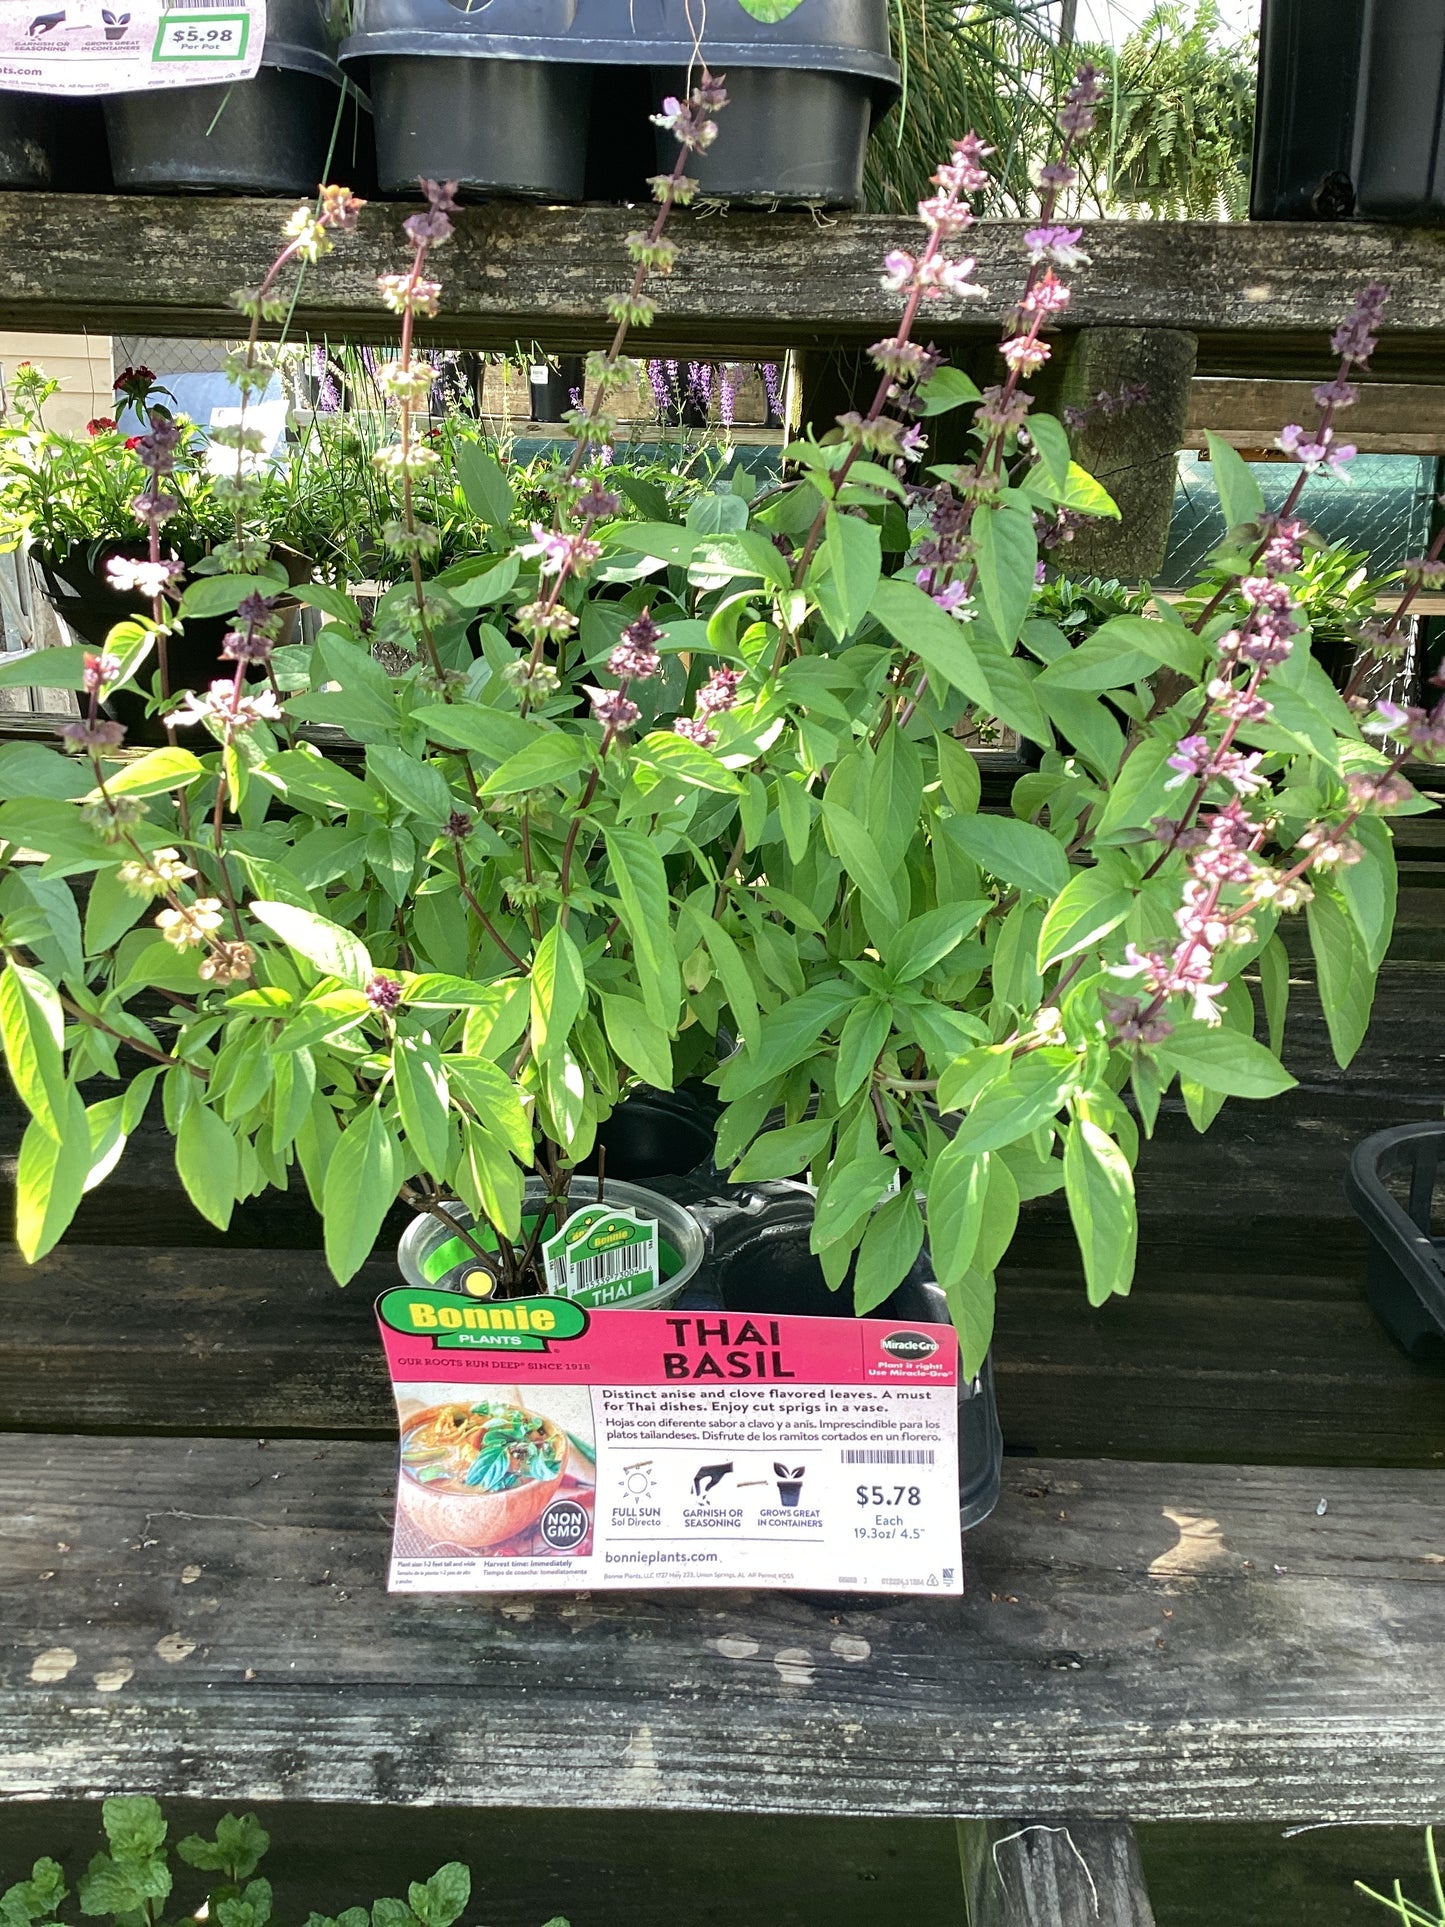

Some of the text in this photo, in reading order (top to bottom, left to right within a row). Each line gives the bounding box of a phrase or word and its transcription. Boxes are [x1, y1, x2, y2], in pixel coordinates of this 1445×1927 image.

[172, 29, 233, 43] $5.98
[592, 1280, 632, 1306] THAI
[408, 1303, 556, 1331] Bonnie
[665, 1318, 780, 1347] THAI
[459, 1334, 522, 1346] PLANTS
[397, 1357, 423, 1366] OUR
[424, 1358, 463, 1367] ROOTS
[465, 1359, 489, 1368] RUN
[527, 1362, 563, 1370] SINCE
[565, 1363, 591, 1371] 1918
[663, 1351, 796, 1379] BASIL
[915, 1362, 943, 1371] right!
[602, 1388, 932, 1400] Distinct anise and clove flavored leaves. A must
[603, 1401, 888, 1414] for Thai dishes. Enjoy cut sprigs in a vase.
[605, 1417, 635, 1429] Hojas
[658, 1418, 707, 1428] diferente
[708, 1418, 736, 1428] sabor
[747, 1419, 775, 1428] clavo
[777, 1421, 783, 1431] y
[785, 1421, 791, 1429] a
[819, 1419, 898, 1431] Imprescindible
[899, 1421, 923, 1431] para
[925, 1420, 941, 1429] los
[606, 1430, 942, 1442] platos tailandeses. Disfrute de los ramitos cortados en un florero.
[856, 1484, 922, 1509] $5.78
[612, 1507, 661, 1517] FULL SUN
[682, 1509, 744, 1518] GARNISH OR
[760, 1509, 821, 1518] GROWS GREAT
[547, 1512, 582, 1526] NON
[611, 1517, 662, 1527] Sol Directo
[684, 1518, 742, 1528] SEASONING
[757, 1518, 823, 1528] IN CONTAINERS
[875, 1514, 904, 1526] Each
[547, 1525, 581, 1538] GMO
[854, 1527, 896, 1539] 19.3oz/
[484, 1559, 573, 1568] Harvest time: Immediately
[604, 1551, 718, 1566] bonnieplants.com
[483, 1569, 505, 1577] Tiempo
